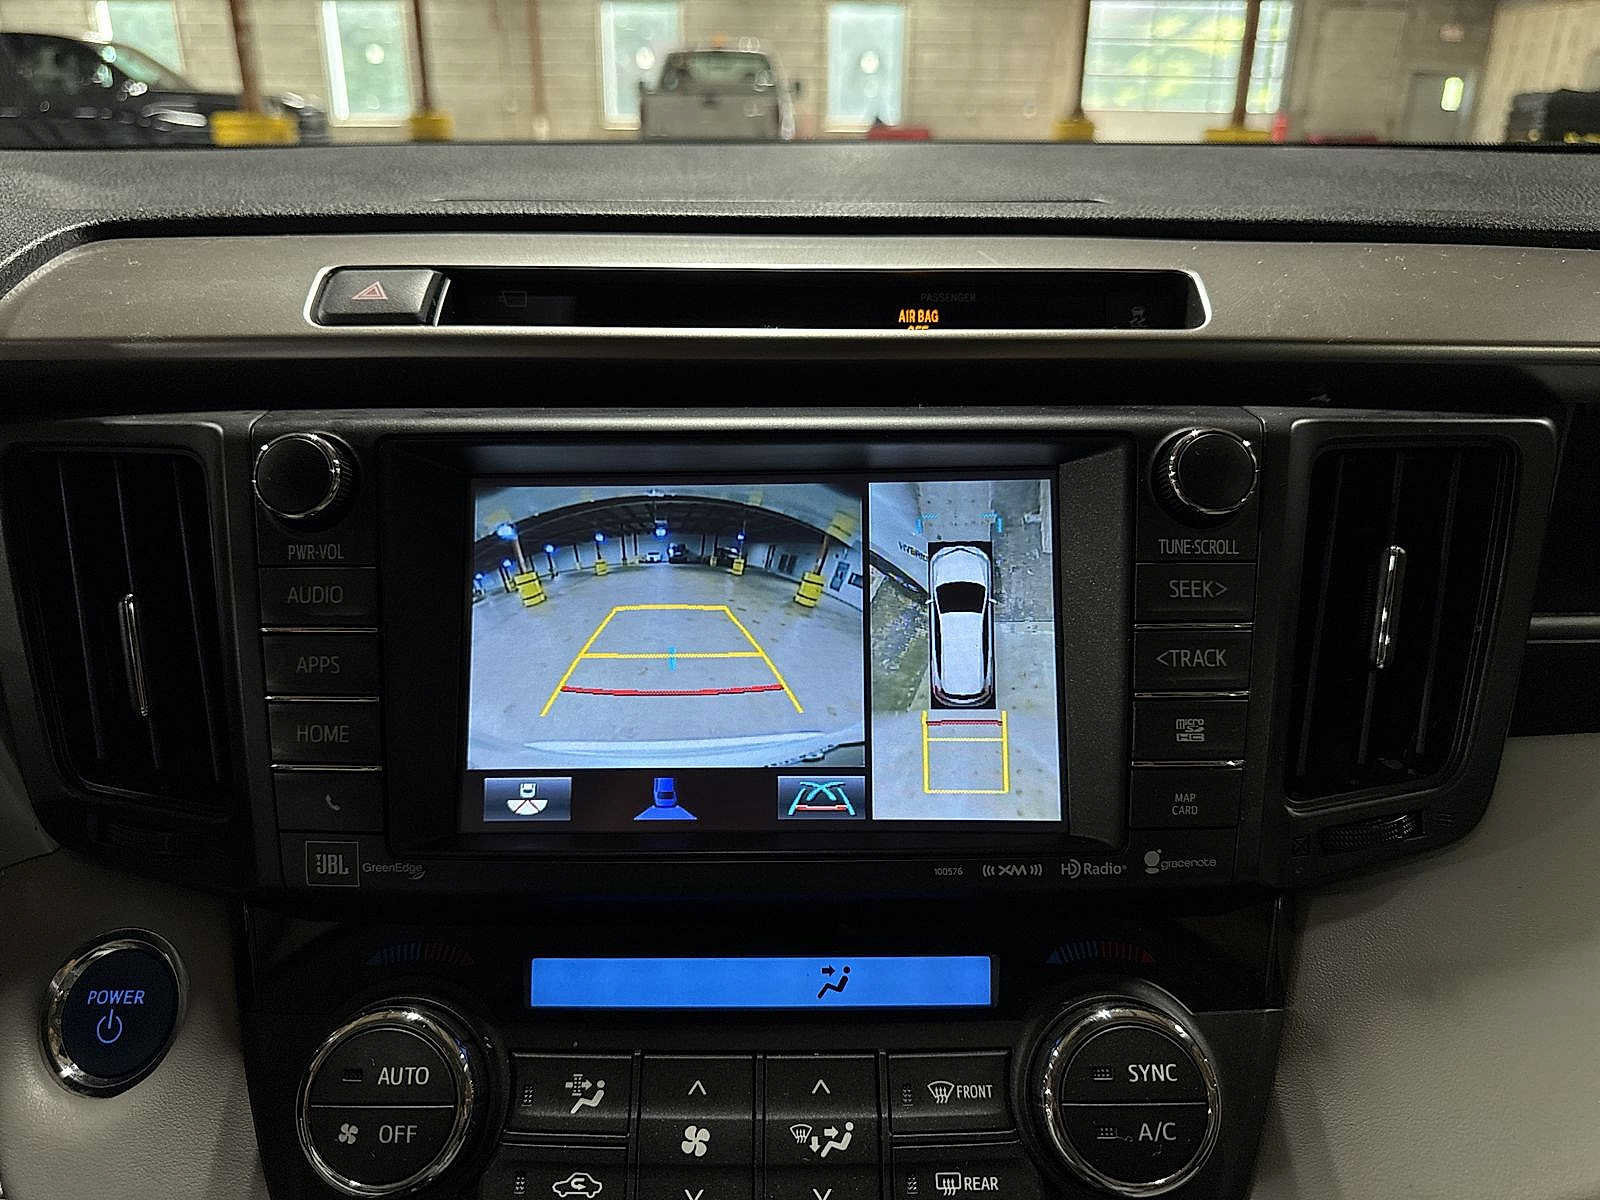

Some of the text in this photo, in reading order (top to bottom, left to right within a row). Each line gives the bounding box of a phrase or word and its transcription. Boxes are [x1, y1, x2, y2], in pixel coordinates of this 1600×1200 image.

[898, 309, 940, 323] AIR BAG
[287, 585, 344, 604] AUDIO
[296, 656, 341, 674] APPS
[296, 725, 350, 743] HOME
[1174, 793, 1196, 803] MAP
[1171, 805, 1198, 816] CARD
[315, 853, 350, 876] JBL
[362, 862, 424, 874] GreenEdge
[998, 864, 1028, 876] XM
[1160, 858, 1217, 871] gracenote
[87, 990, 146, 1006] POWER
[377, 1066, 430, 1086] AUTO
[1127, 1063, 1179, 1084] SYNC
[956, 1084, 993, 1100] FRONT
[378, 1125, 418, 1144] OFF
[1137, 1122, 1177, 1143] A/C
[963, 1176, 999, 1192] REAR
